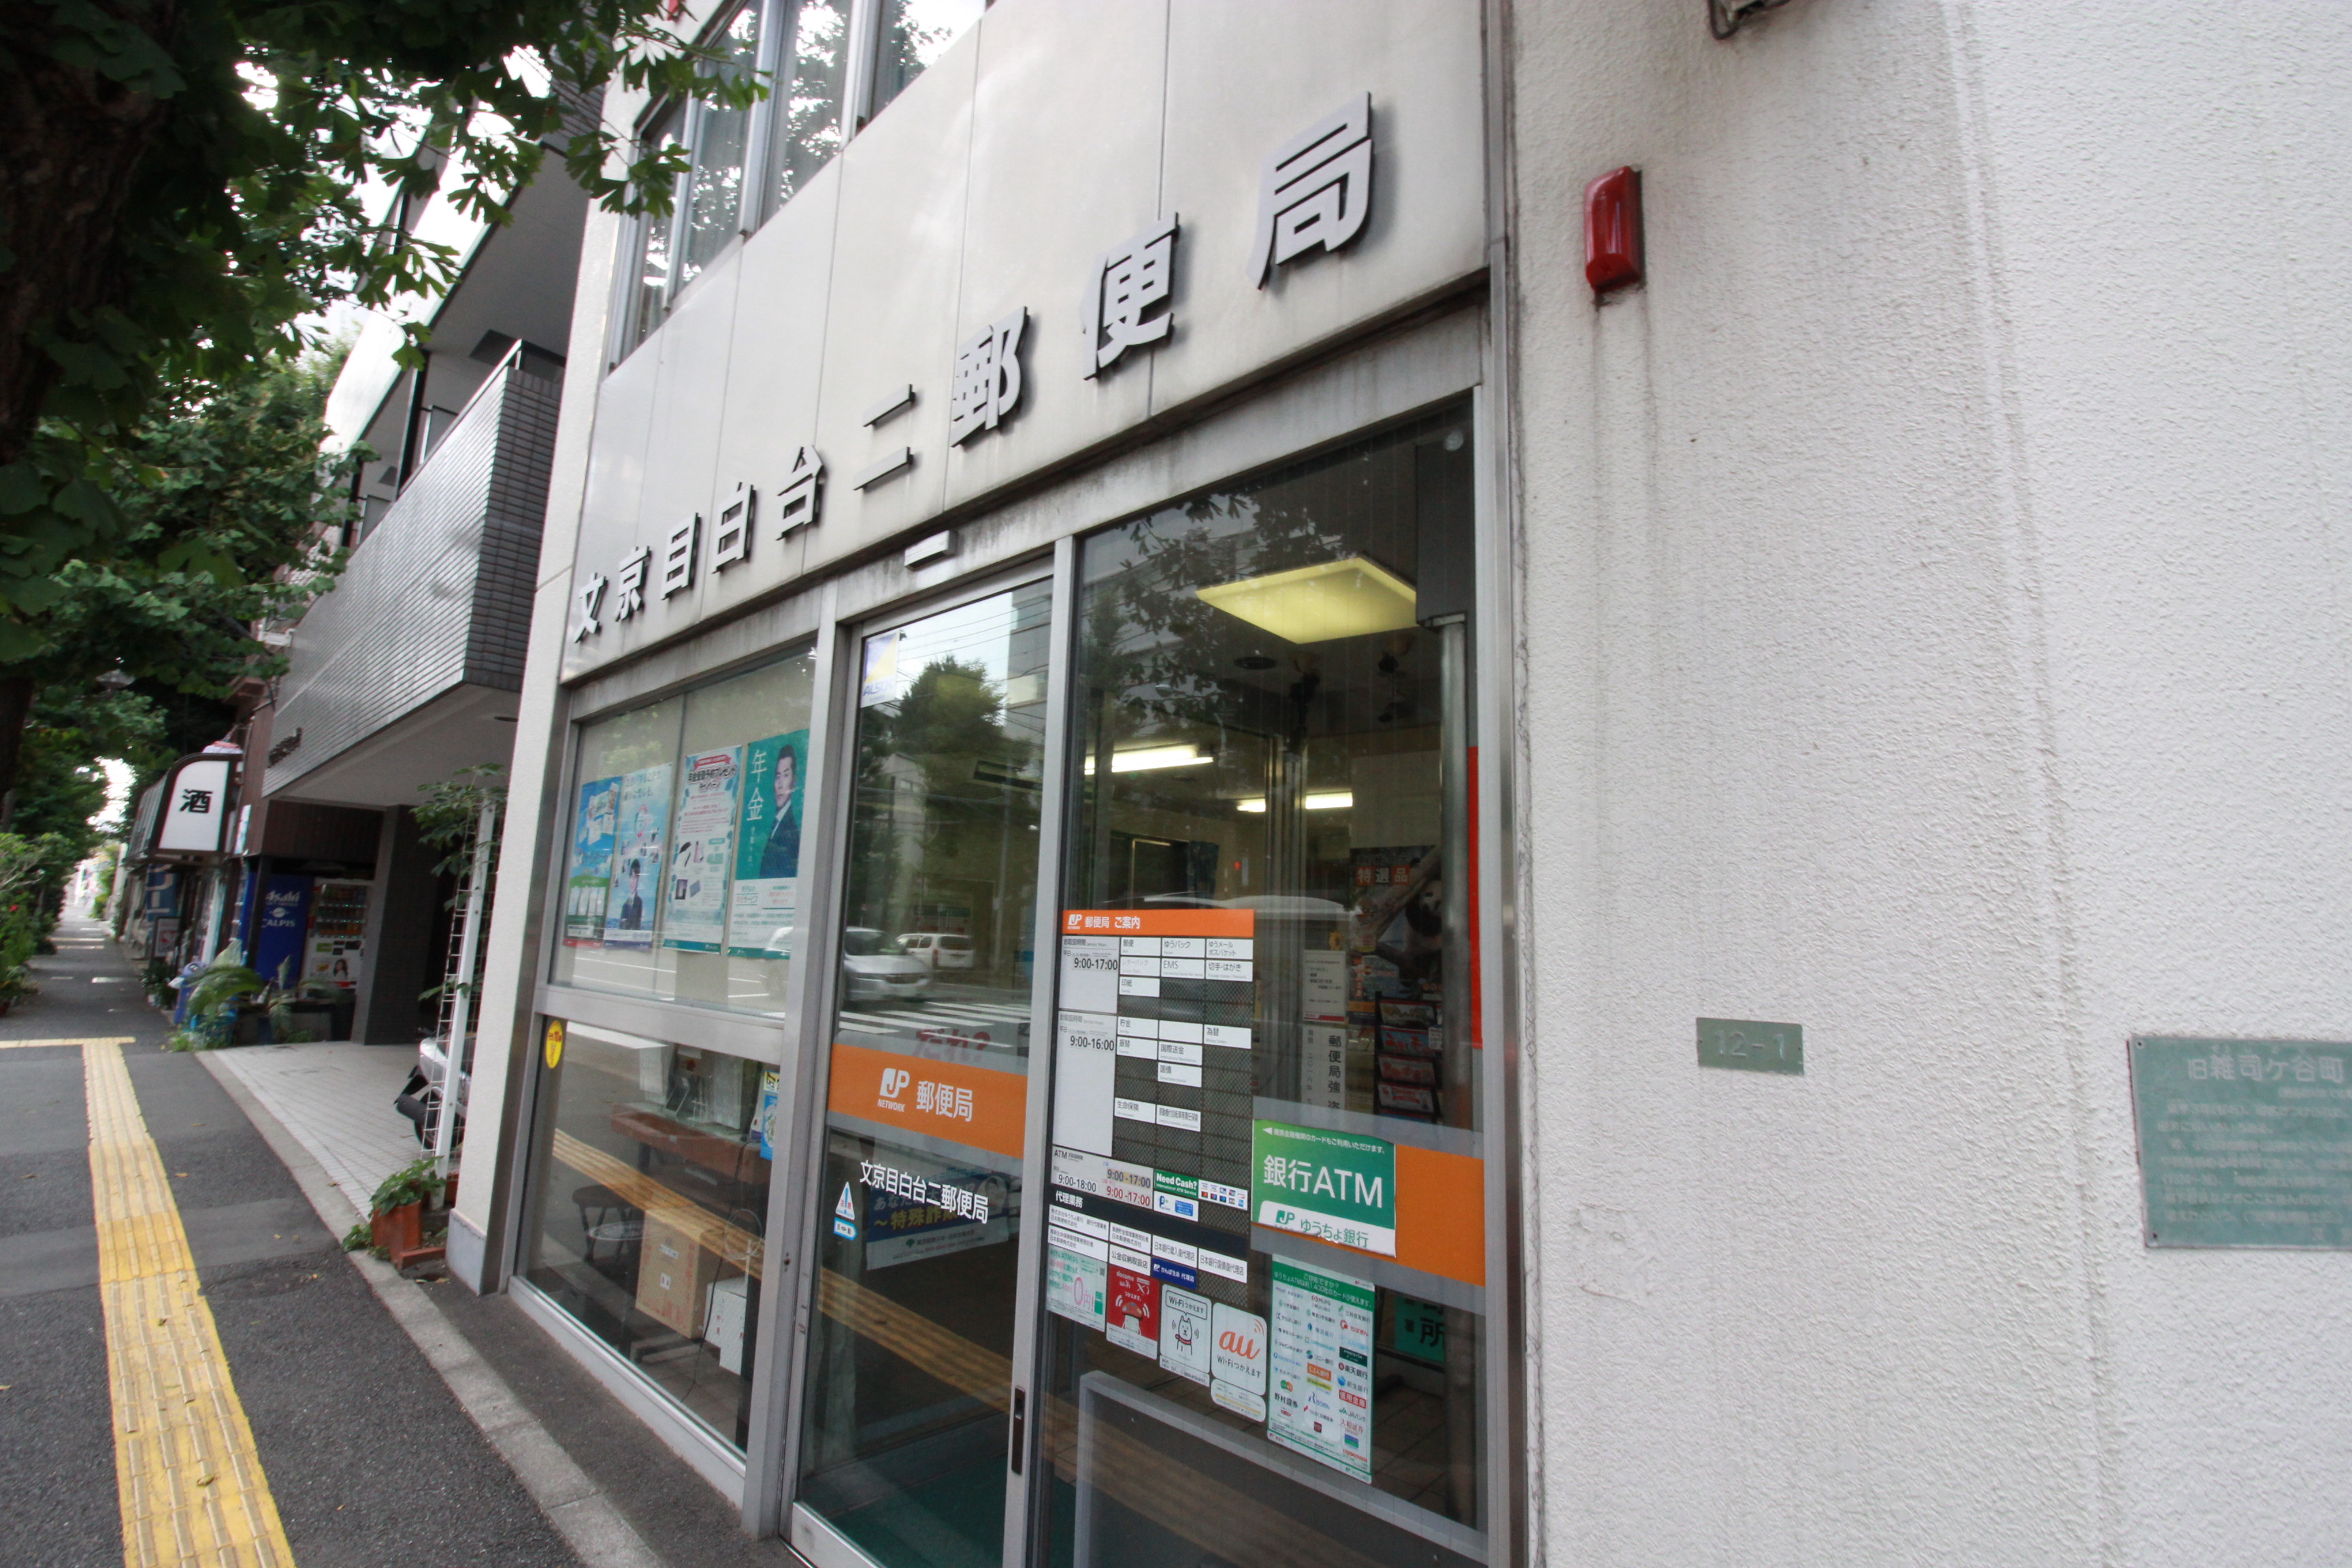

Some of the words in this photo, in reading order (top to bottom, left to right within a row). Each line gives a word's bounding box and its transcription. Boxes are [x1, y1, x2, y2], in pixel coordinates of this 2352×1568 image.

[573, 91, 1373, 643] 文京目白台二郵便局
[747, 749, 767, 821] 年金
[180, 788, 214, 814] 酒
[1358, 866, 1409, 885] 特選品
[265, 889, 301, 902] Asahi
[261, 918, 296, 928] CALPIS
[1085, 916, 1109, 928] 郵便局
[1114, 916, 1141, 930] ご案内
[1123, 939, 1134, 947] 郵便
[1164, 940, 1191, 949] ゆうパック
[1074, 957, 1118, 970] 9:00-17:00
[1163, 960, 1179, 969] EMS
[1070, 1035, 1115, 1051] 9:00-16:00
[1714, 1030, 1785, 1061] 12-1
[877, 1098, 906, 1113] NETWORK
[916, 1080, 974, 1122] 郵便局
[1117, 1100, 1140, 1112] 生命保険
[1054, 1149, 1068, 1160] ATM
[1058, 1174, 1097, 1192] 9:00-18:00
[1156, 1173, 1175, 1185] Need
[1175, 1177, 1198, 1190] Cash?
[1263, 1154, 1383, 1209] 銀行ATM
[859, 1160, 990, 1224] 文京目白台二郵便局
[1056, 1190, 1084, 1209] 代理業務
[1300, 1218, 1369, 1248] ゆうちょ銀行
[1116, 1271, 1134, 1281] docomo
[1161, 1267, 1181, 1277] かんぽ生命
[1181, 1273, 1195, 1283] 代理店
[1219, 1331, 1261, 1360] au
[1217, 1355, 1262, 1378] Wi-Fiつかえます
[1344, 1365, 1368, 1380] 楽天銀行
[1339, 1390, 1367, 1408] 信用金庫
